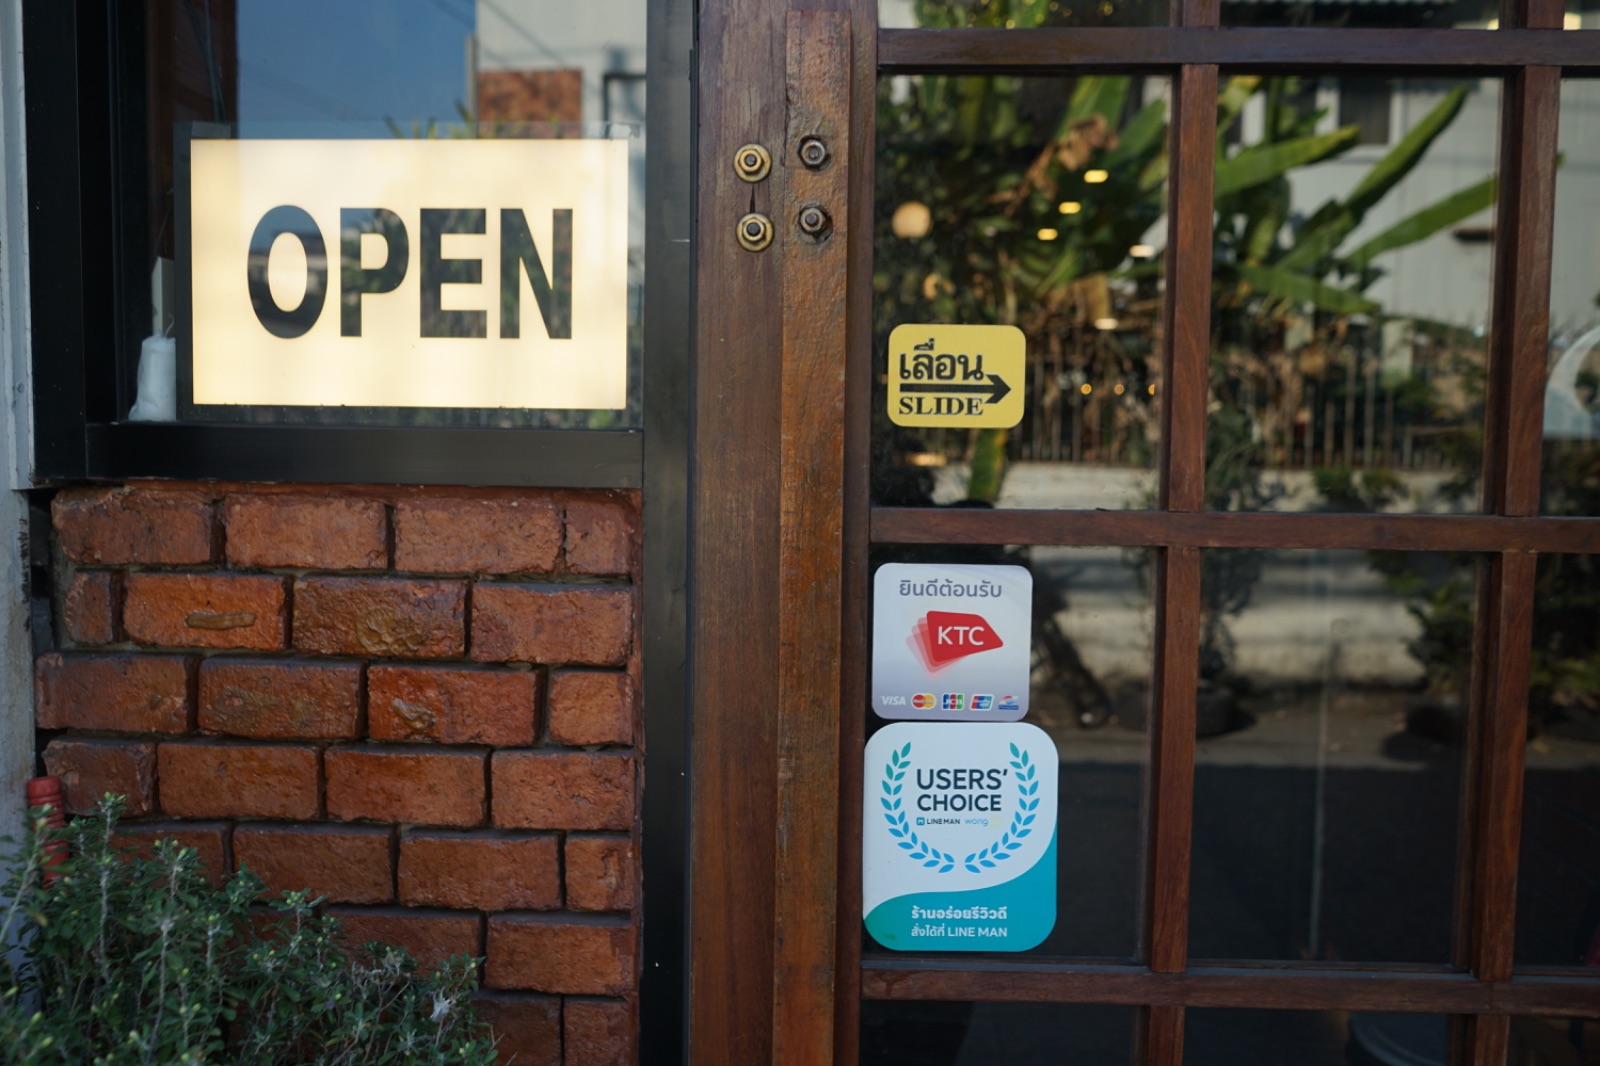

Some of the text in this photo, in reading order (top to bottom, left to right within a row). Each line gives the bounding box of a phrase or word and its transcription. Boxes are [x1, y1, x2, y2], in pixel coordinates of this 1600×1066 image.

[247, 205, 573, 339] OPEN
[899, 338, 984, 381] เลื่อน
[899, 396, 983, 416] SLIDE
[899, 578, 1003, 598] ยินดีต้อนรับ
[937, 625, 985, 646] KTC
[880, 695, 906, 706] VISA
[916, 793, 1002, 812] CHOICE
[911, 905, 1008, 920] ร้านอร่อยรีวิวดี
[911, 923, 1008, 938] สั่งได้ที่ LINE MAN
